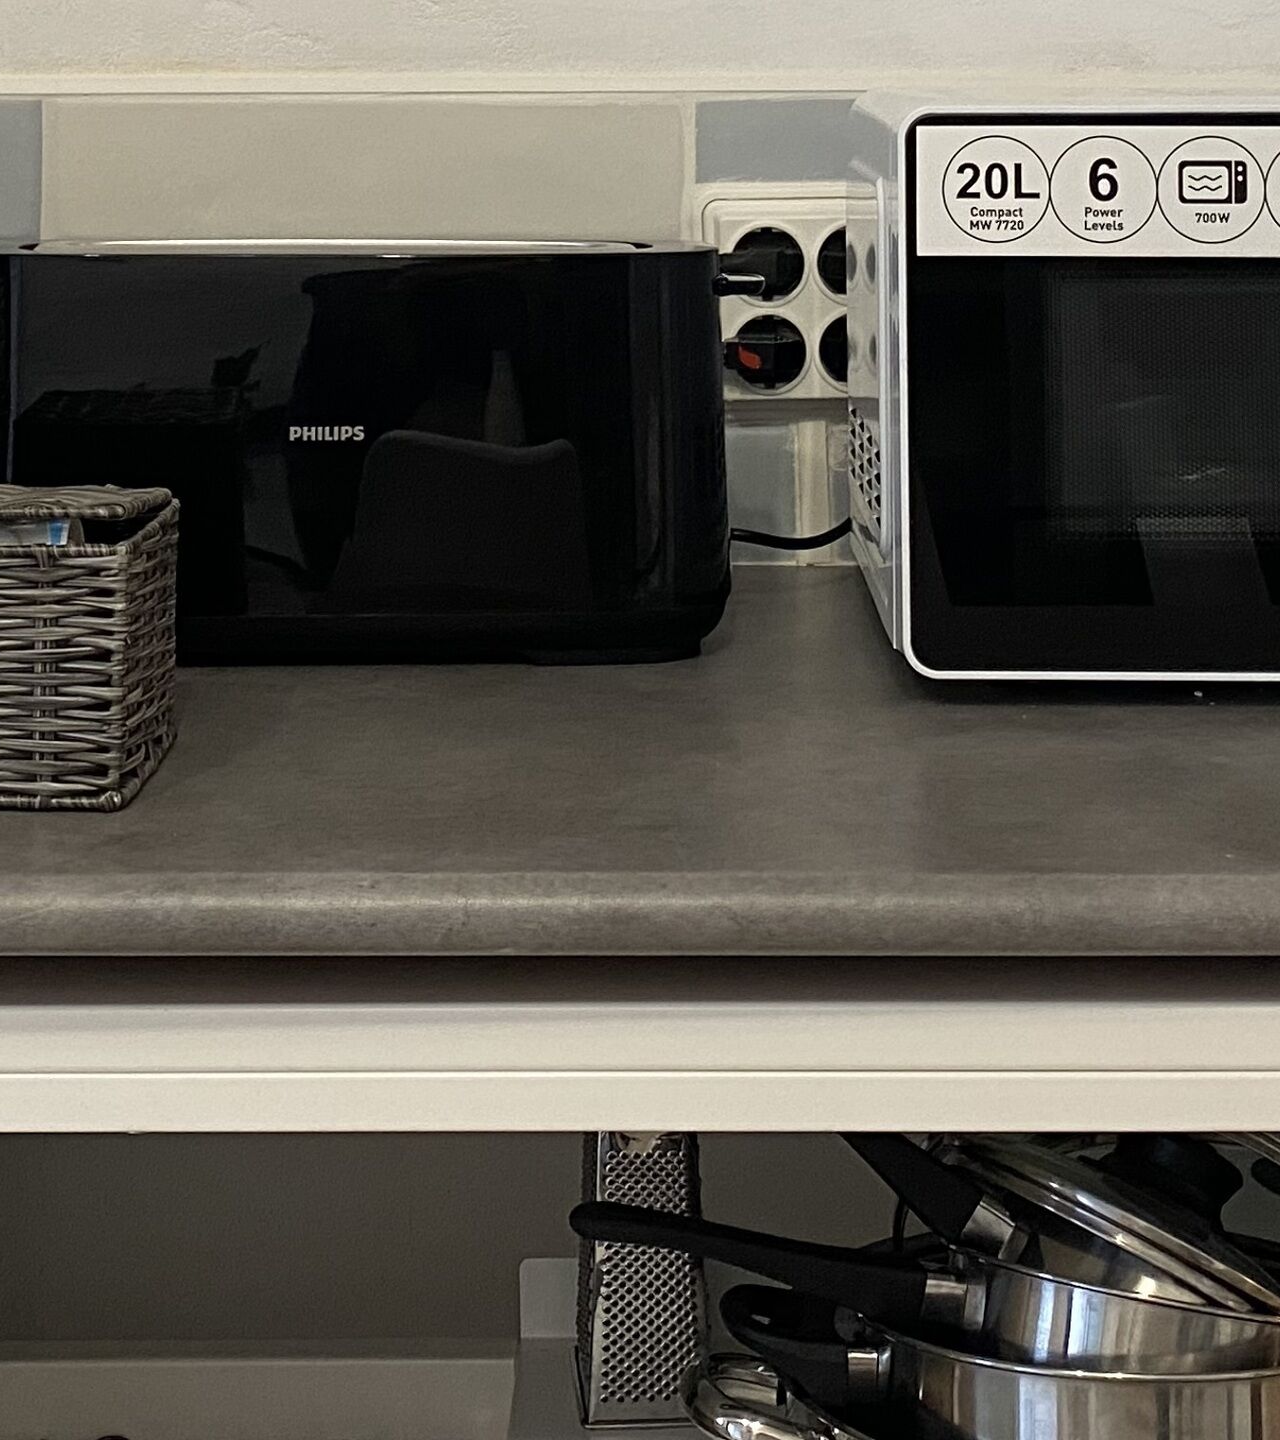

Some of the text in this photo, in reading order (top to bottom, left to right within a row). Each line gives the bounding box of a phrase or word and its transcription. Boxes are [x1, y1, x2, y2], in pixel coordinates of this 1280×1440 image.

[955, 162, 1041, 200] 20L
[1088, 156, 1120, 202] 6
[969, 206, 1024, 220] Compact
[1083, 206, 1124, 219] Power
[1194, 212, 1231, 224] 700W
[969, 219, 1024, 231] MW 7720
[1083, 219, 1124, 232] Levels
[288, 425, 365, 442] PHILIPS
